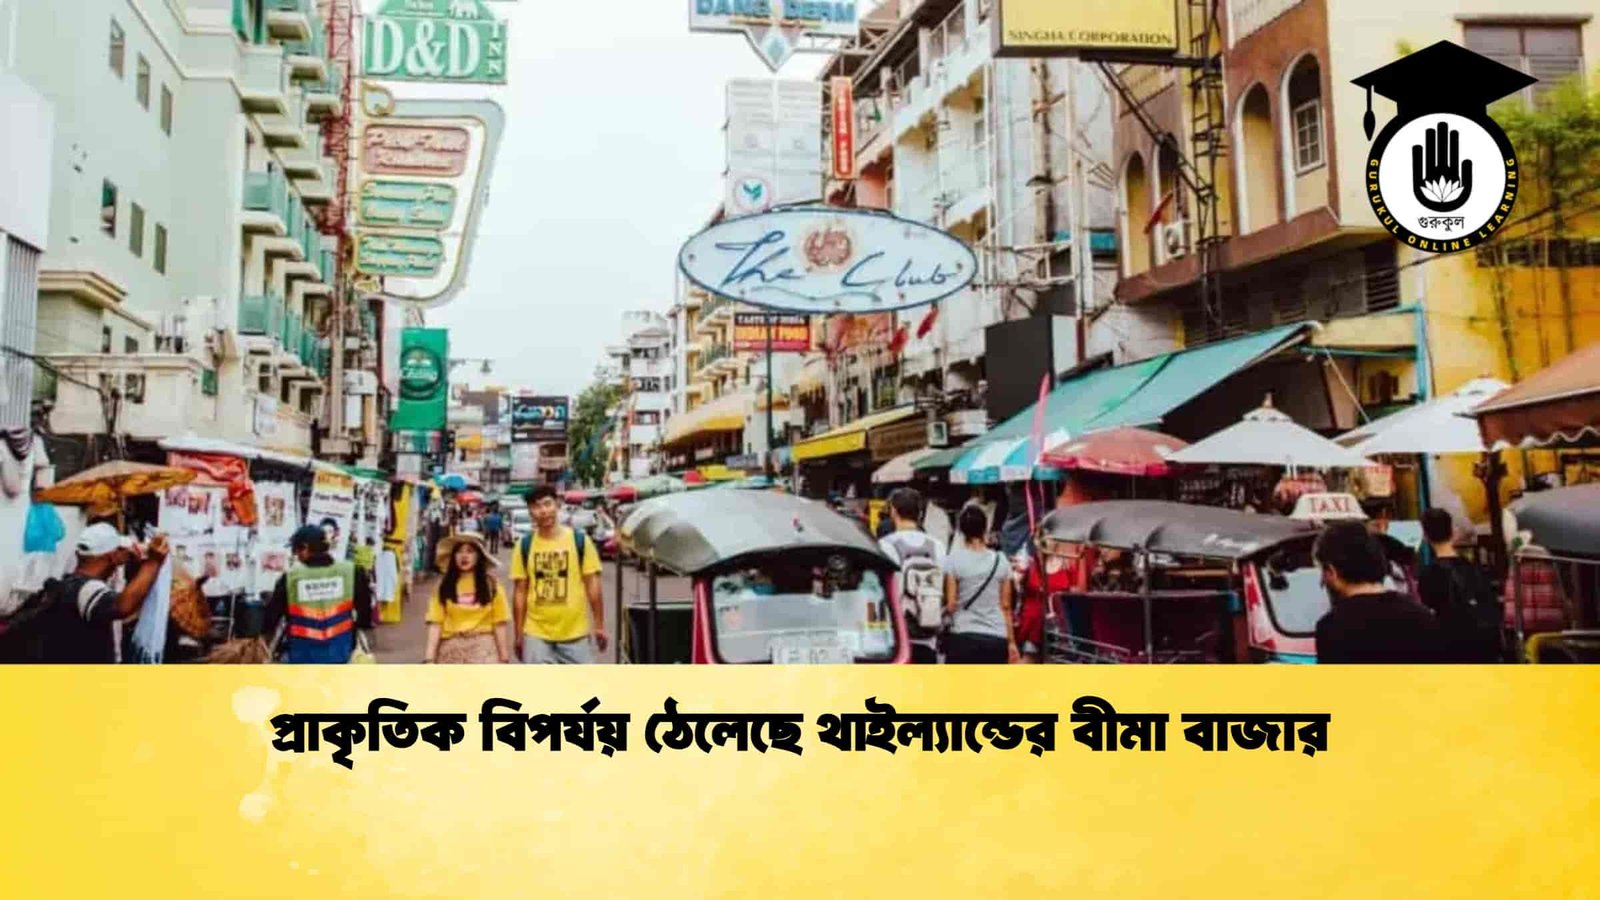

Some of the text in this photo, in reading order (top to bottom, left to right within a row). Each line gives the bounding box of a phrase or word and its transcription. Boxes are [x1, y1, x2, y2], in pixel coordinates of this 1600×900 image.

[366, 16, 481, 78] D&D
[487, 21, 503, 76] INN
[1008, 29, 1172, 44] SINGHA CORPORATION
[714, 230, 954, 289] The Club
[1309, 495, 1350, 513] TAXI
